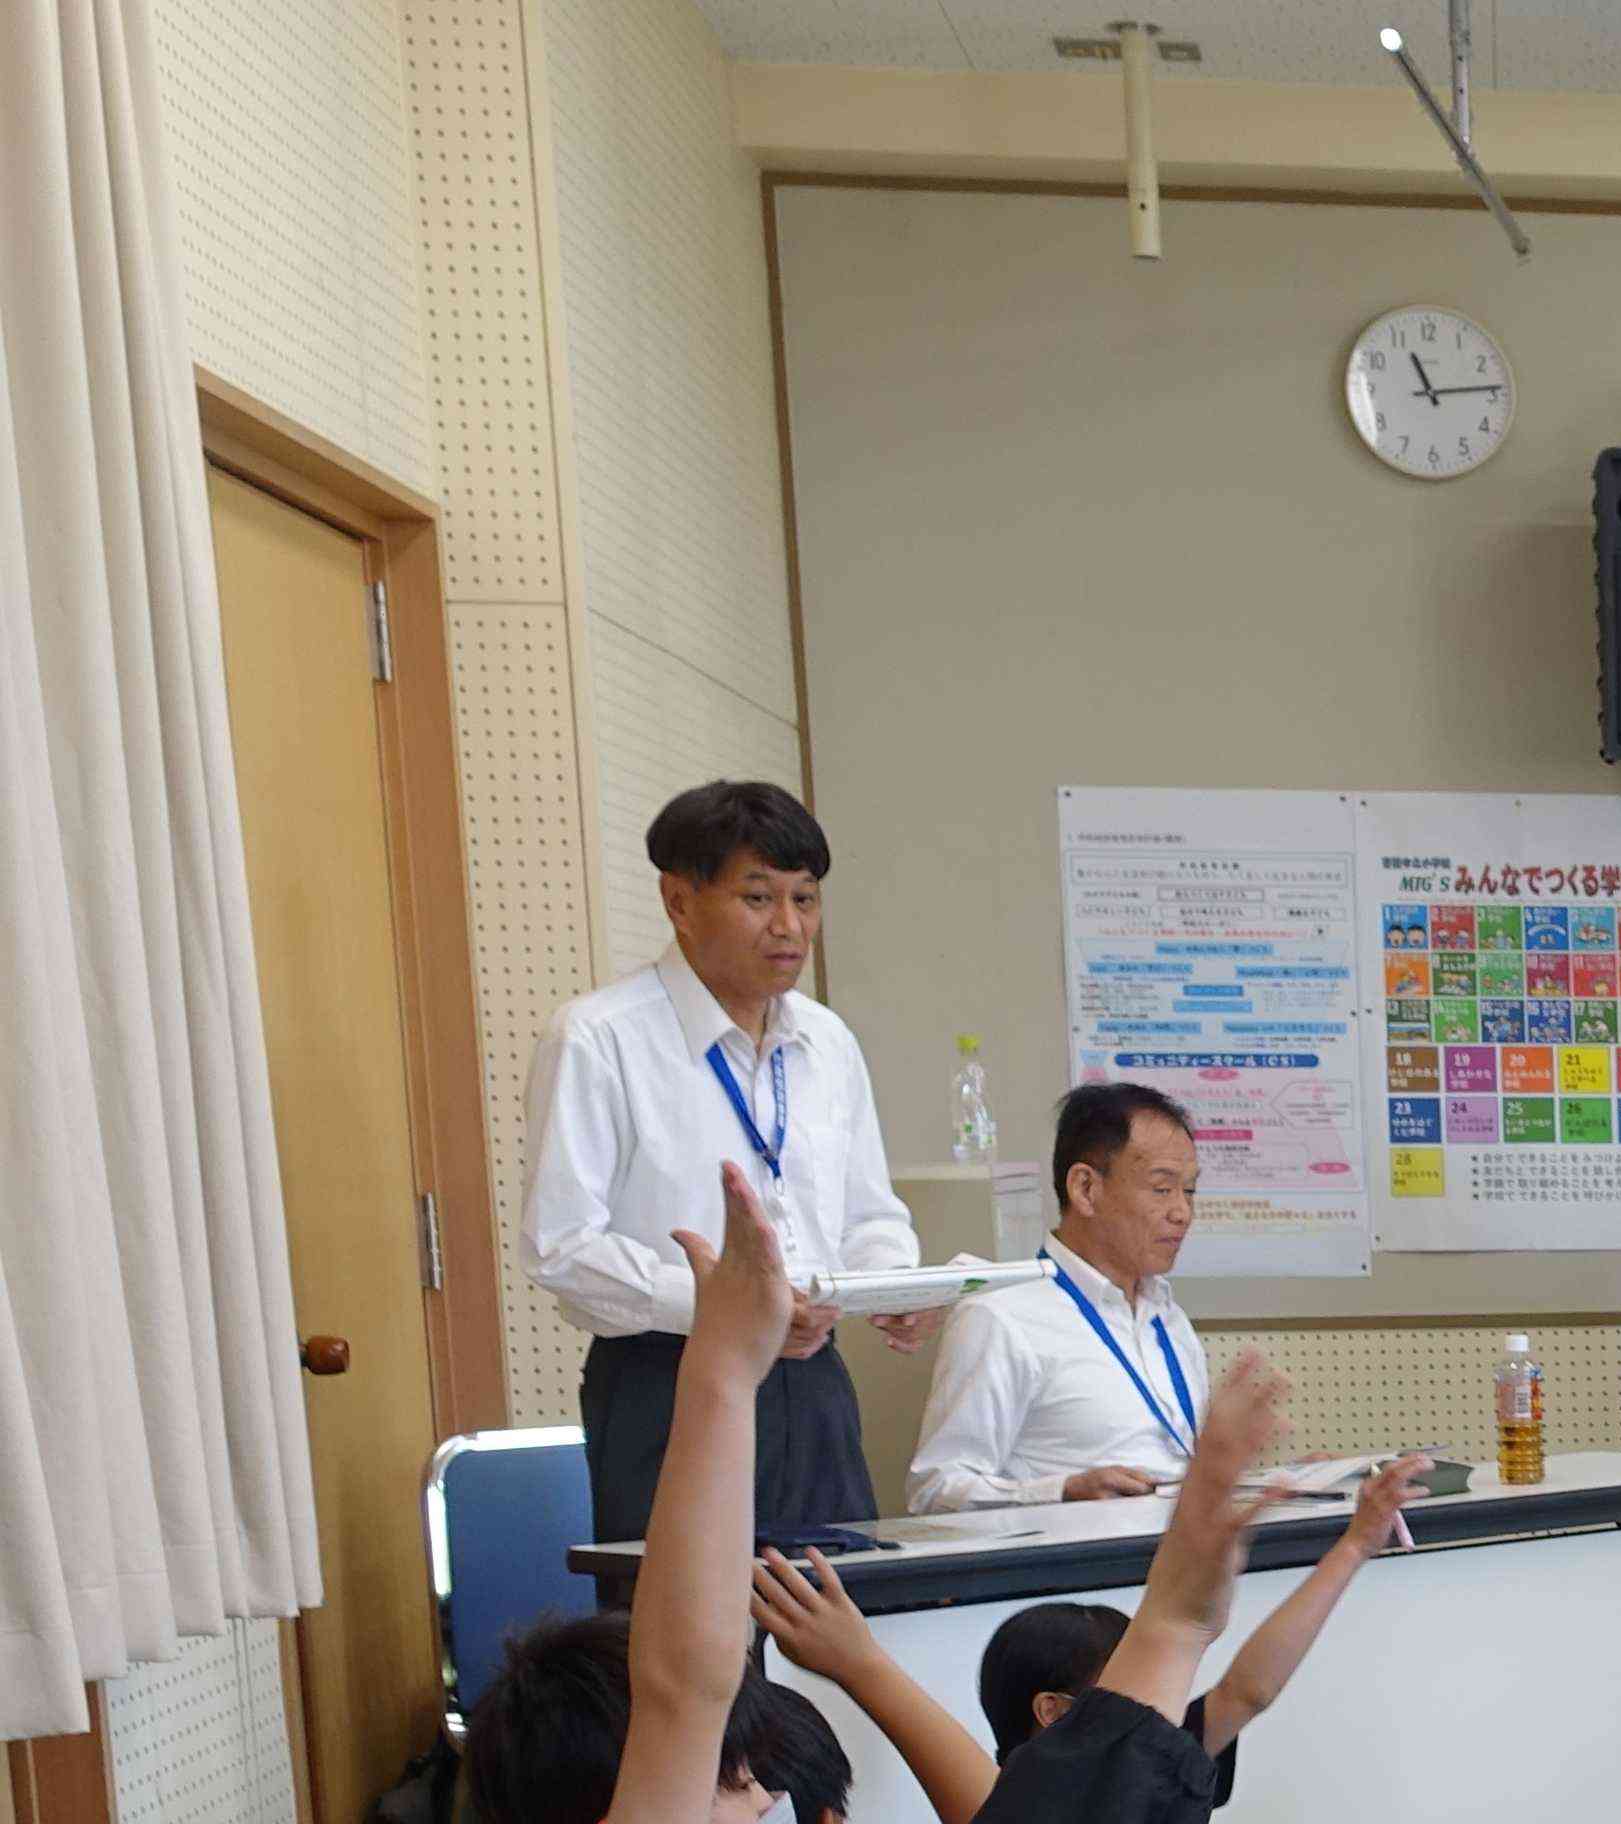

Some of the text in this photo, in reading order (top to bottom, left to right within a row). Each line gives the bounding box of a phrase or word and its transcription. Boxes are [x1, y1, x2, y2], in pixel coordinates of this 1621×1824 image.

[1420, 321, 1437, 342] 12
[1476, 355, 1487, 373] 2
[1478, 416, 1489, 433] 4
[1397, 435, 1410, 454] 7
[1458, 436, 1469, 455] 5
[1427, 445, 1439, 463] 6
